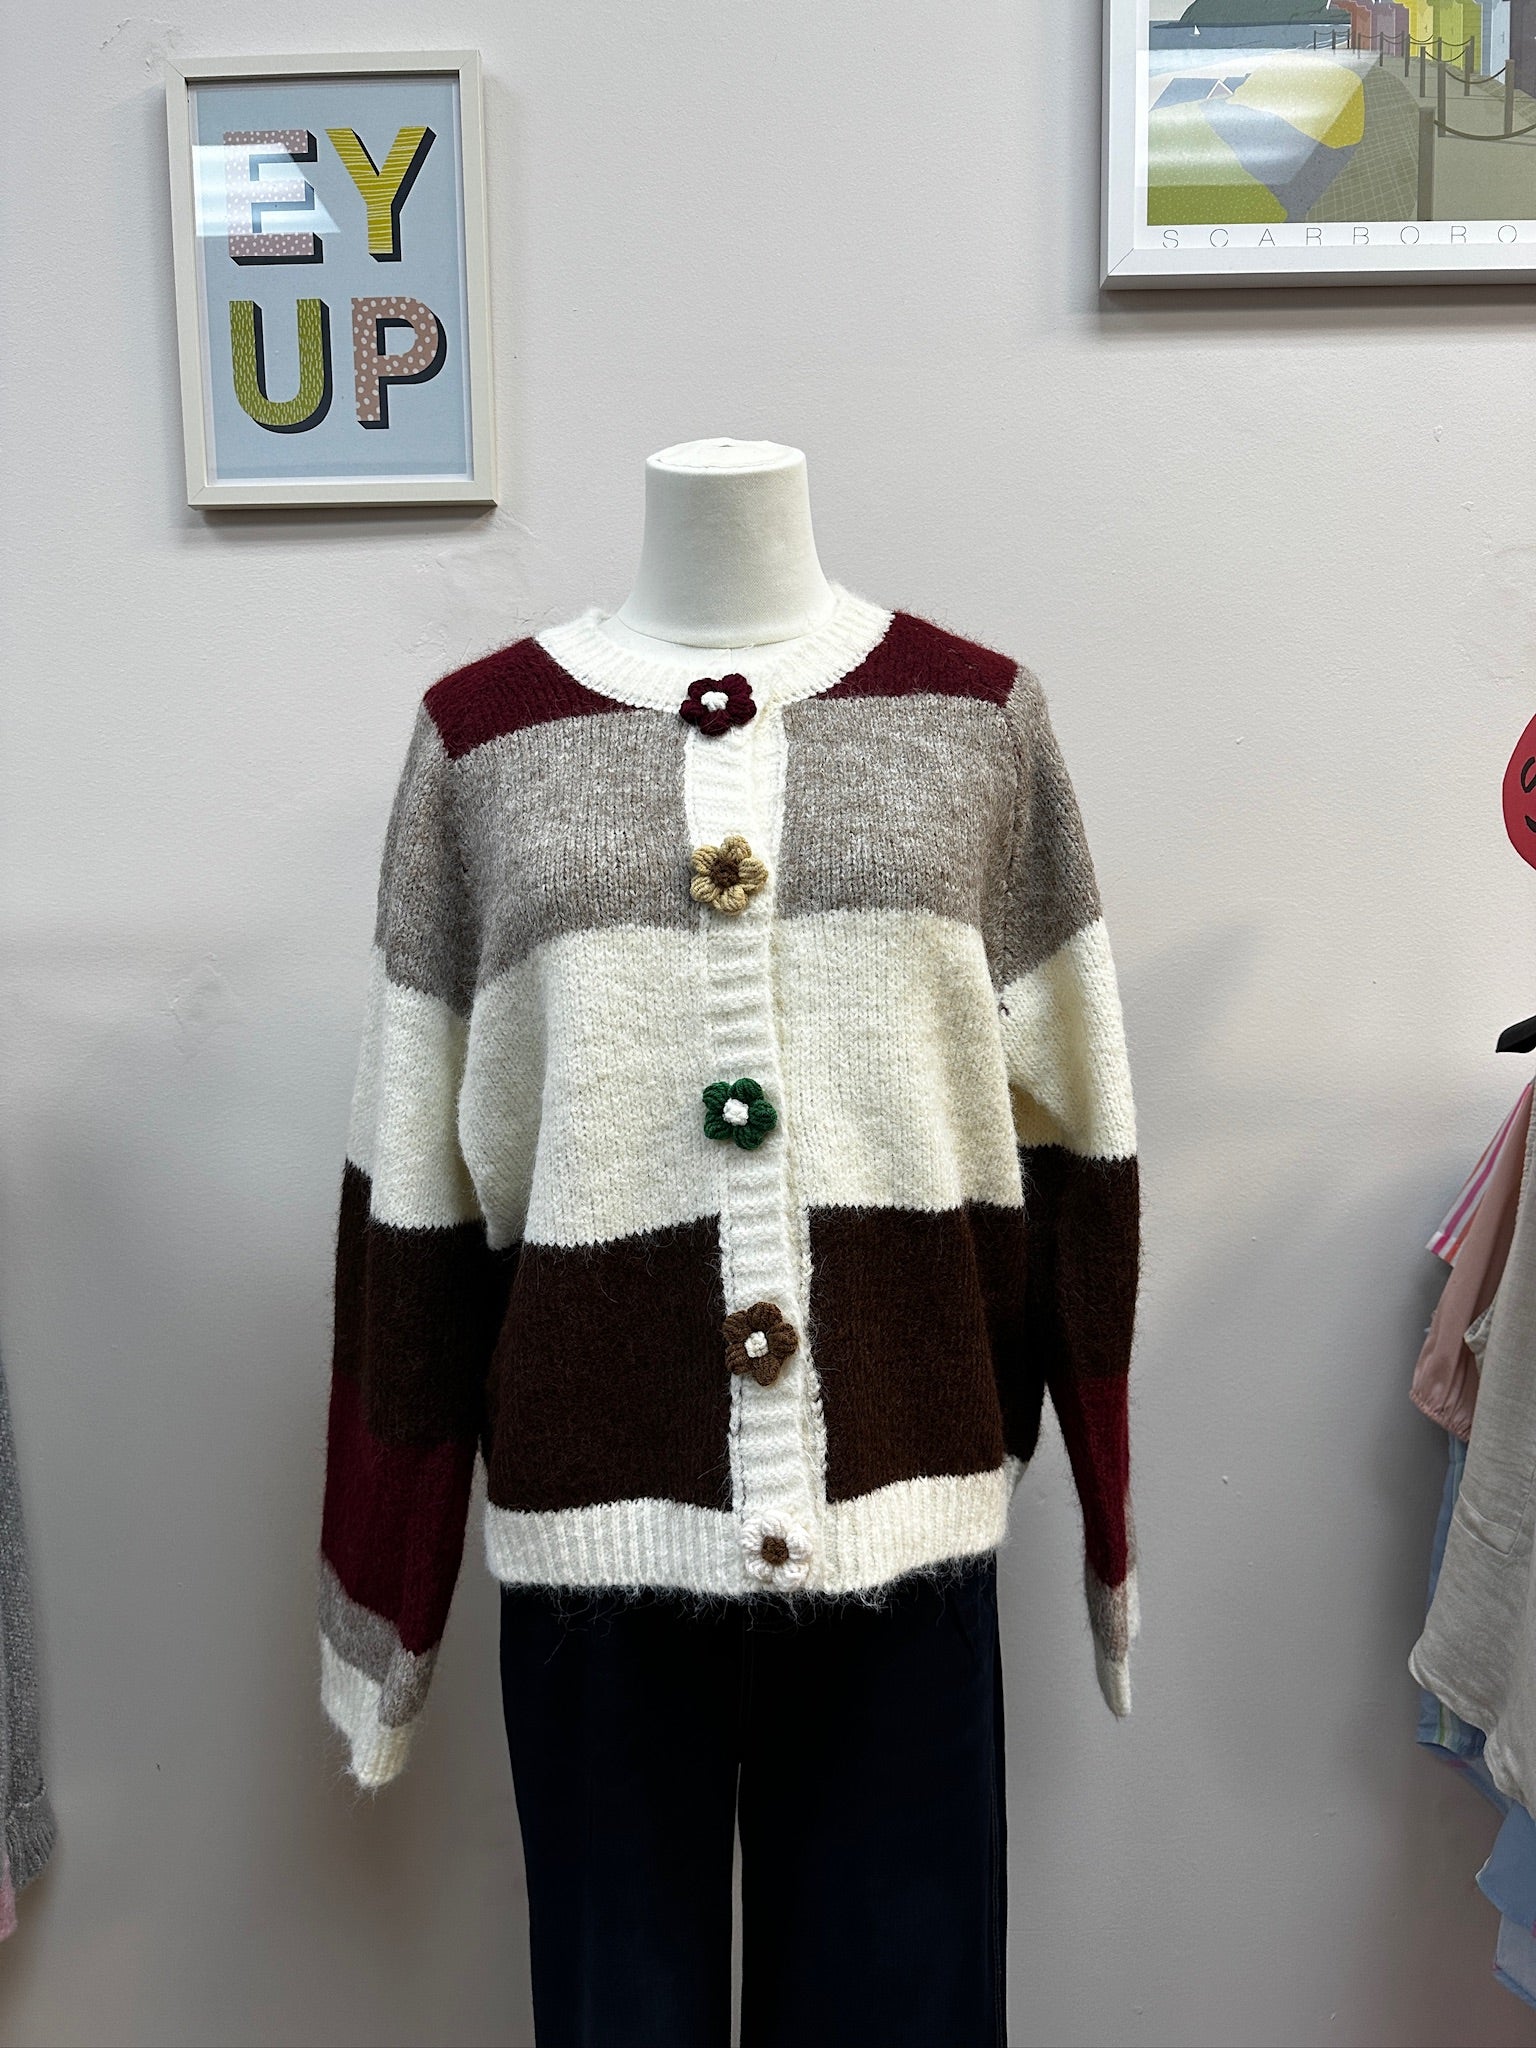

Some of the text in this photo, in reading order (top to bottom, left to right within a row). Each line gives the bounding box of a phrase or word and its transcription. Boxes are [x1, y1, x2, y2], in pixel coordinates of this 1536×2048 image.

[223, 126, 437, 266] EY
[1162, 224, 1518, 249] SCARBORO
[229, 296, 447, 435] UP
